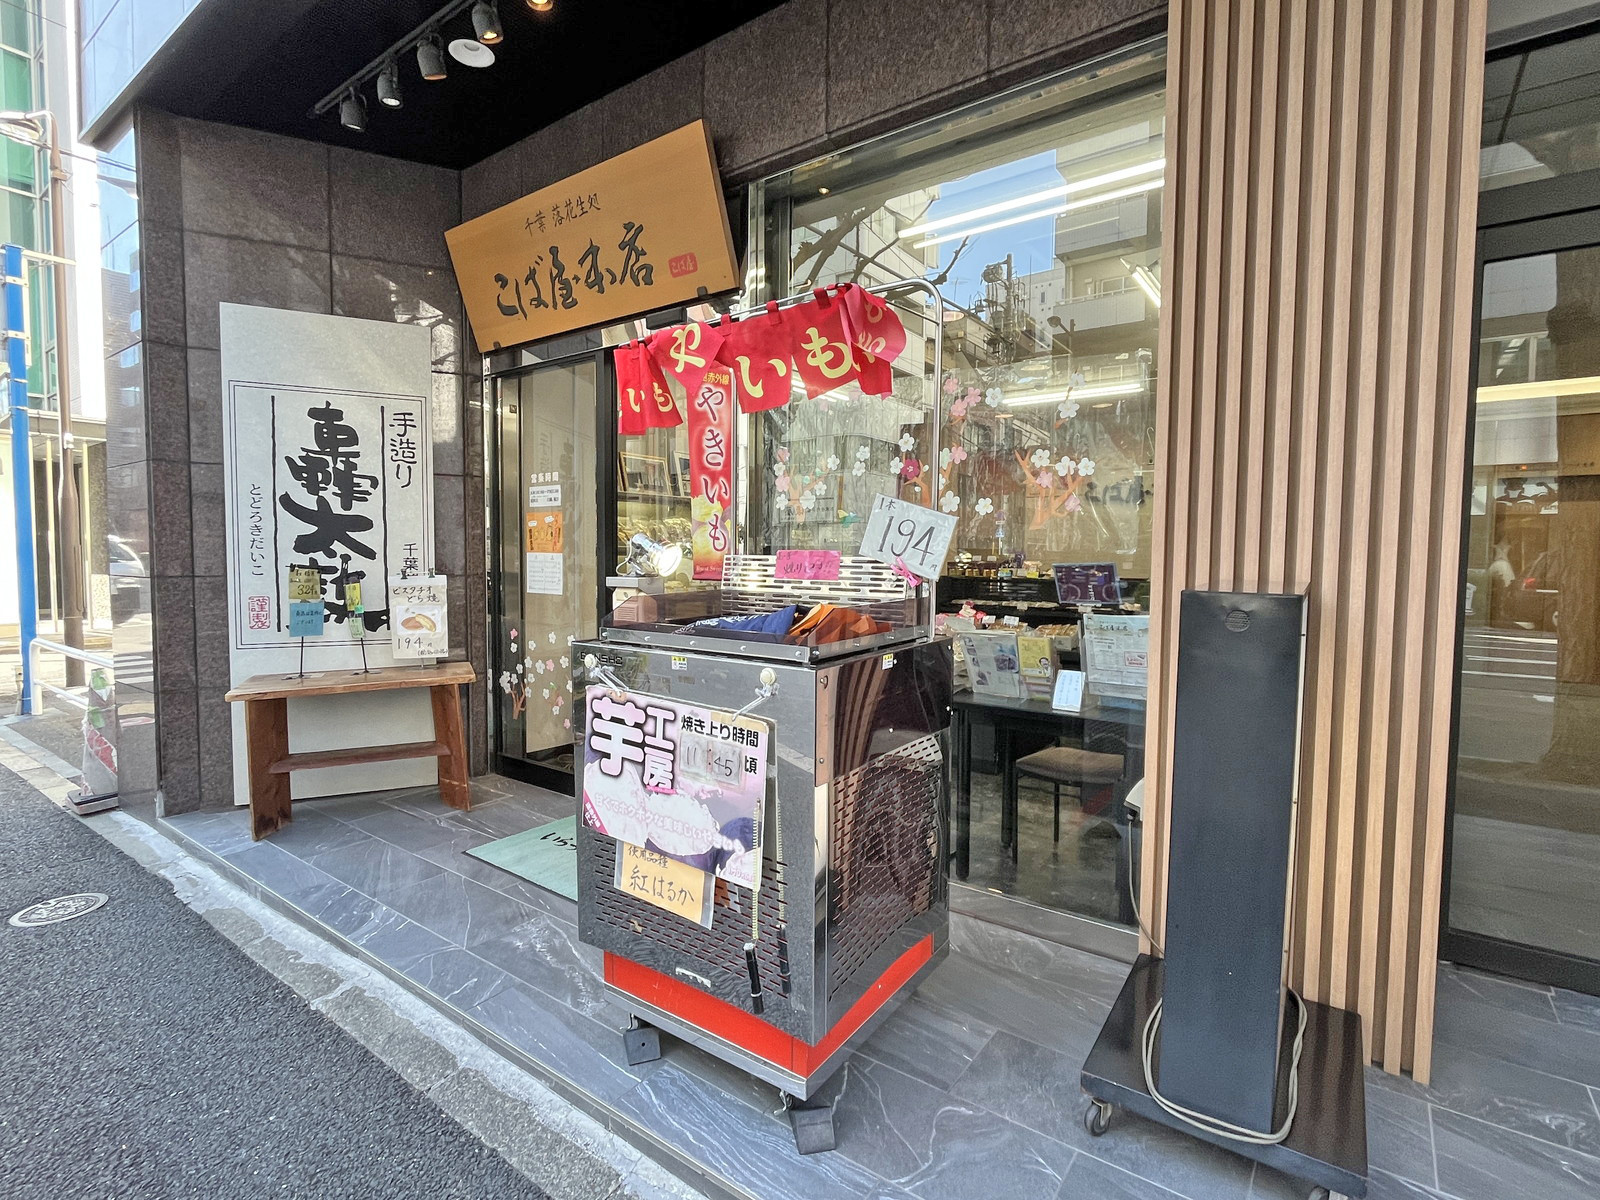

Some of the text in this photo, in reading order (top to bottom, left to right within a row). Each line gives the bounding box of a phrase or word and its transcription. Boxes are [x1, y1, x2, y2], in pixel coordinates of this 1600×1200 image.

[523, 192, 601, 237] 千葉 落花生処
[494, 221, 654, 320] こば屋本店
[389, 411, 418, 488] 手造り
[697, 387, 728, 552] やきいも
[249, 484, 264, 576] とどろきだいこ
[681, 715, 759, 748] 焼き上り時間
[744, 755, 758, 775] 頃
[629, 864, 694, 904] 紅はるか
